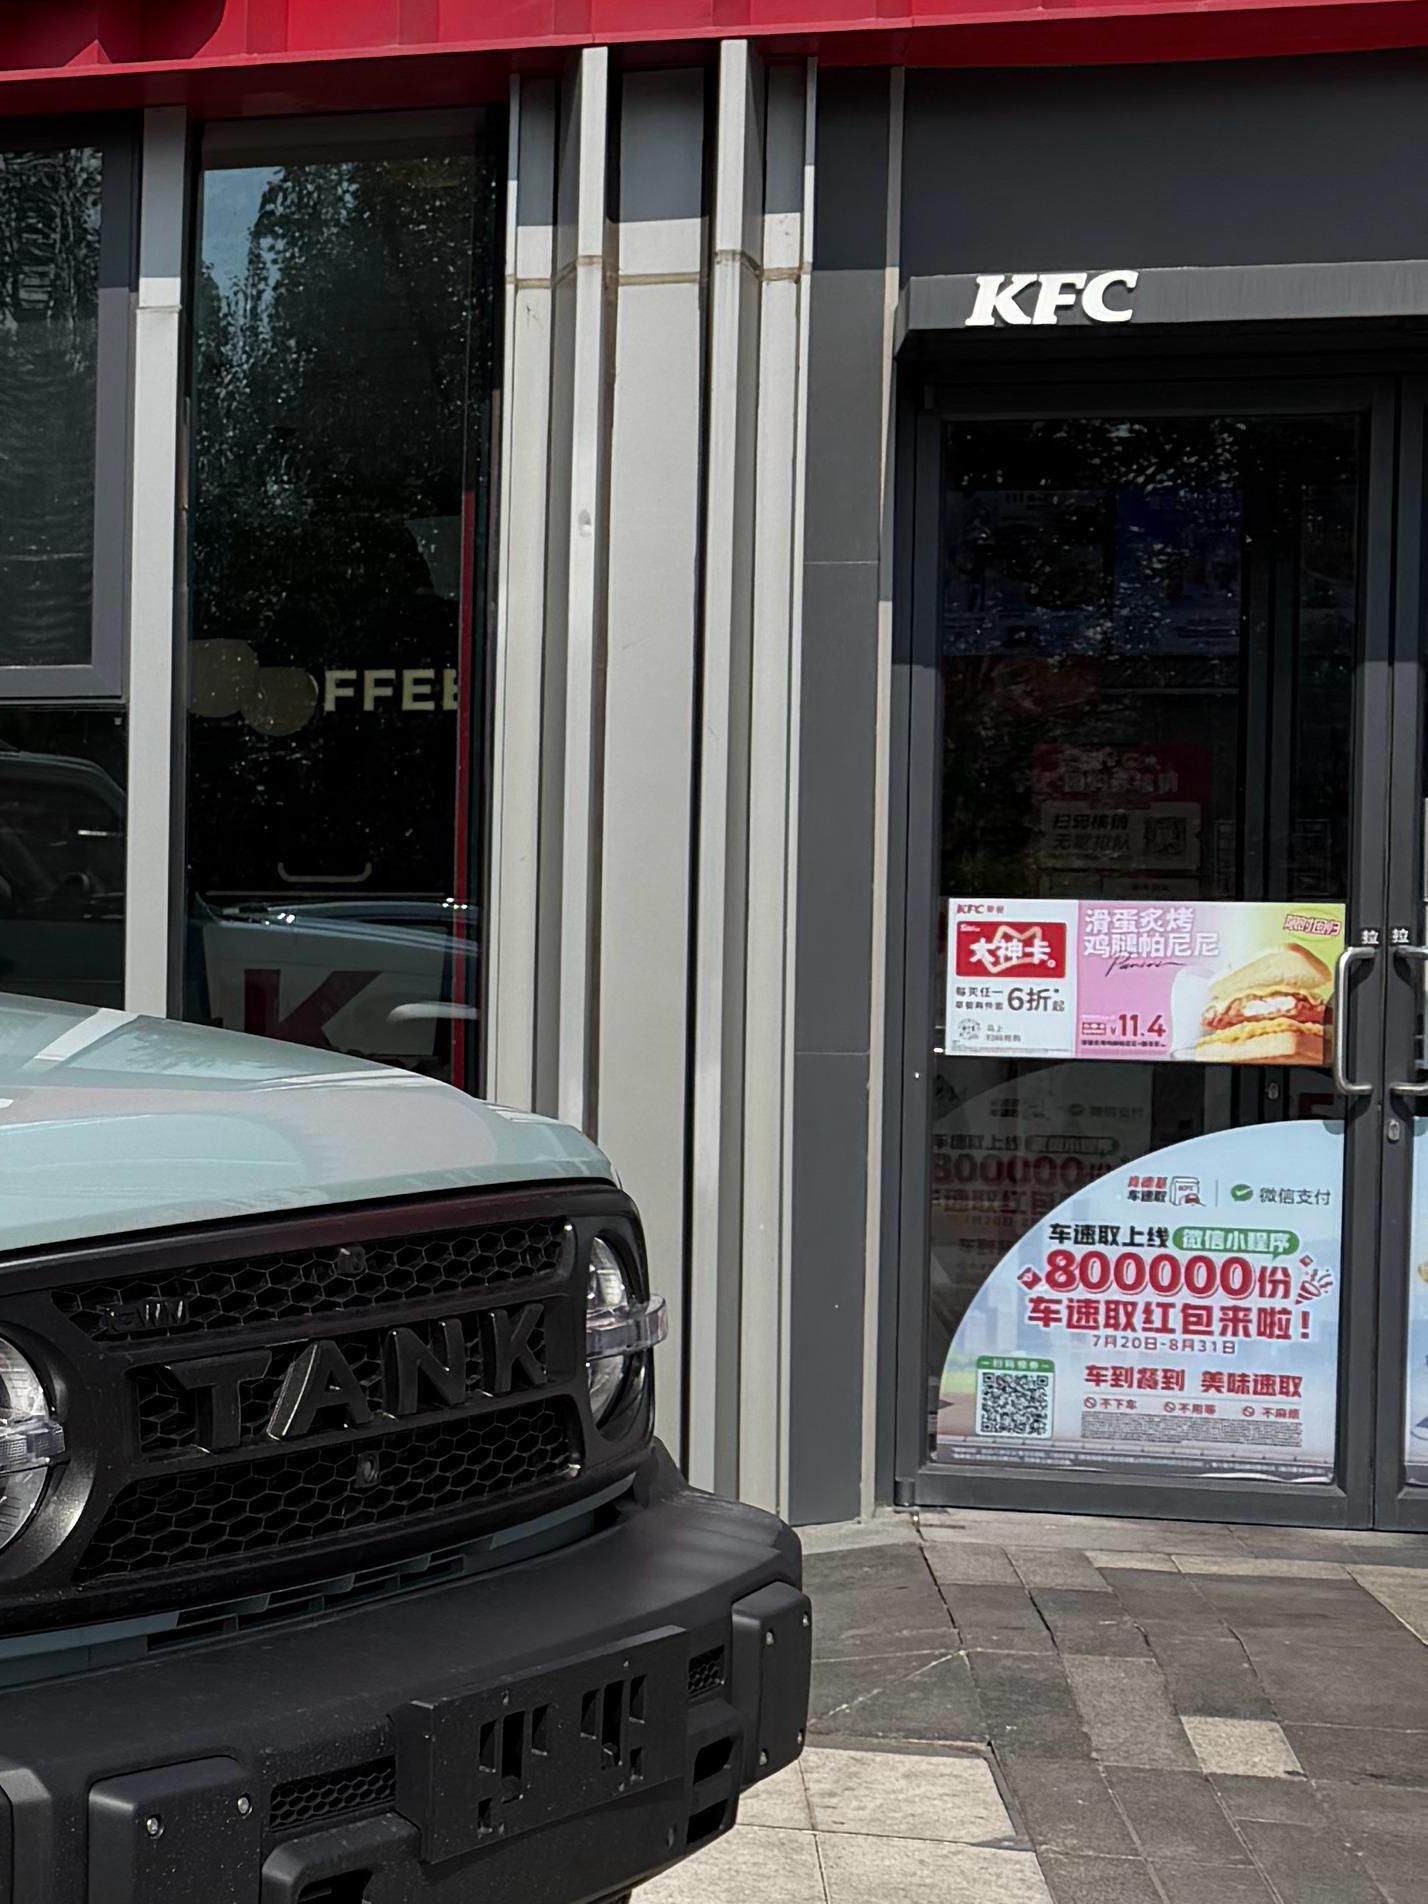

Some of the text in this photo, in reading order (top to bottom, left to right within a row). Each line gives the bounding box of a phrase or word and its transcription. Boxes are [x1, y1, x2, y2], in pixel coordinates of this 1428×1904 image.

[965, 270, 1138, 327] KFC
[956, 904, 985, 914] KFC
[1085, 908, 1194, 934] 滑蛋炙烤
[1083, 933, 1219, 958] 鸡腿帕尼尼
[1362, 929, 1379, 944] 拉
[1392, 928, 1409, 943] 拉
[969, 937, 1051, 965] 大神卡
[1118, 1013, 1167, 1038] 11.4
[1259, 1186, 1331, 1206] 微信支付
[1048, 1223, 1290, 1254] 车速取上线 微信小程序
[1045, 1249, 1293, 1301] 800000份
[1092, 1333, 1236, 1355] 7月20日-8月31日
[158, 1302, 547, 1453] TANK
[1084, 1364, 1304, 1398] 车到餐到 美味速取
